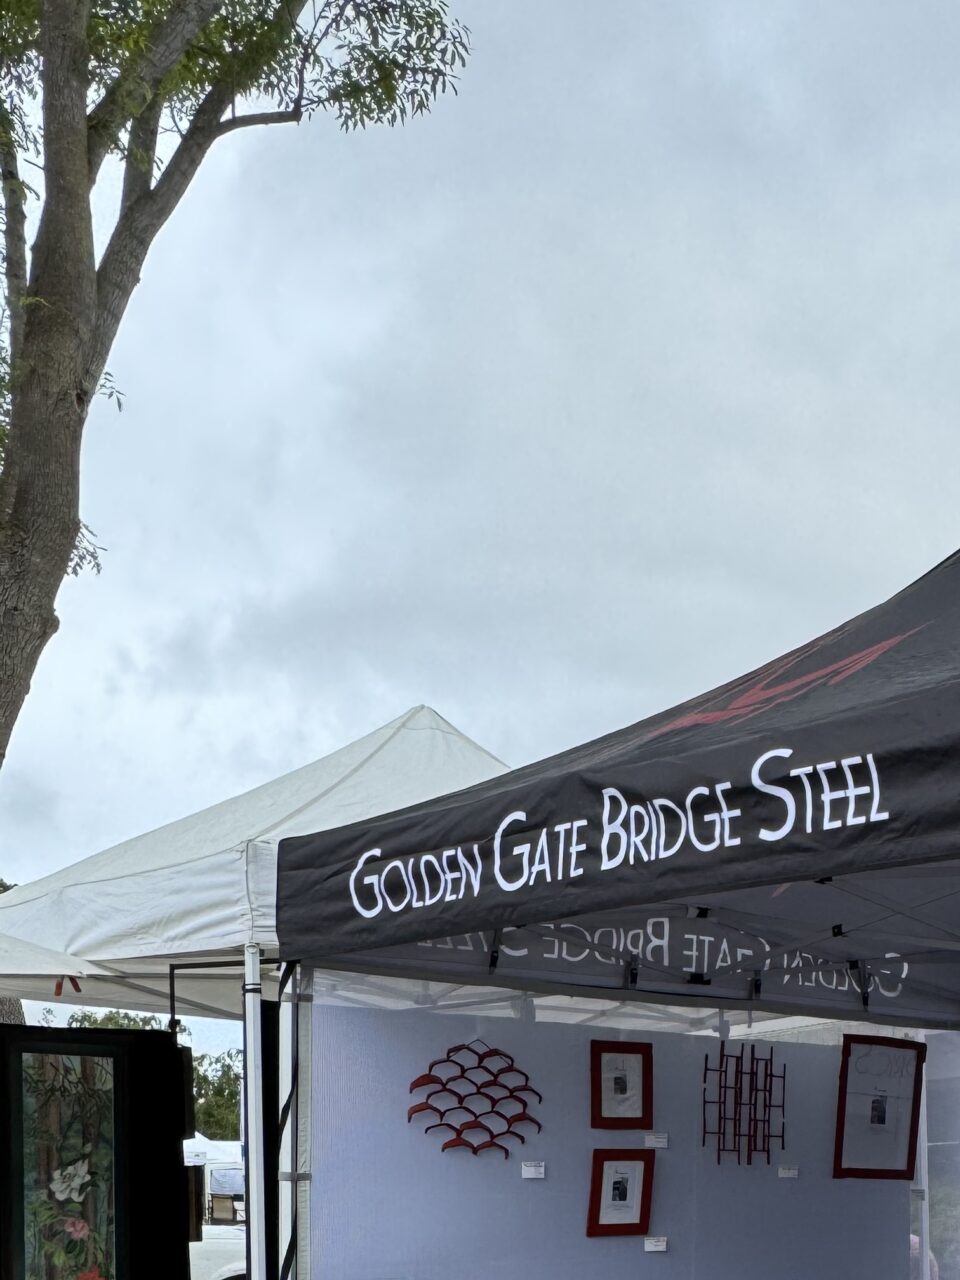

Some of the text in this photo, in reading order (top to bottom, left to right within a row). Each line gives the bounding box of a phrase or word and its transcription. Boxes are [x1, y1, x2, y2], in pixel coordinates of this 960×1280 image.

[349, 748, 890, 918] GOLDEN GATE BRIDGE STEEL
